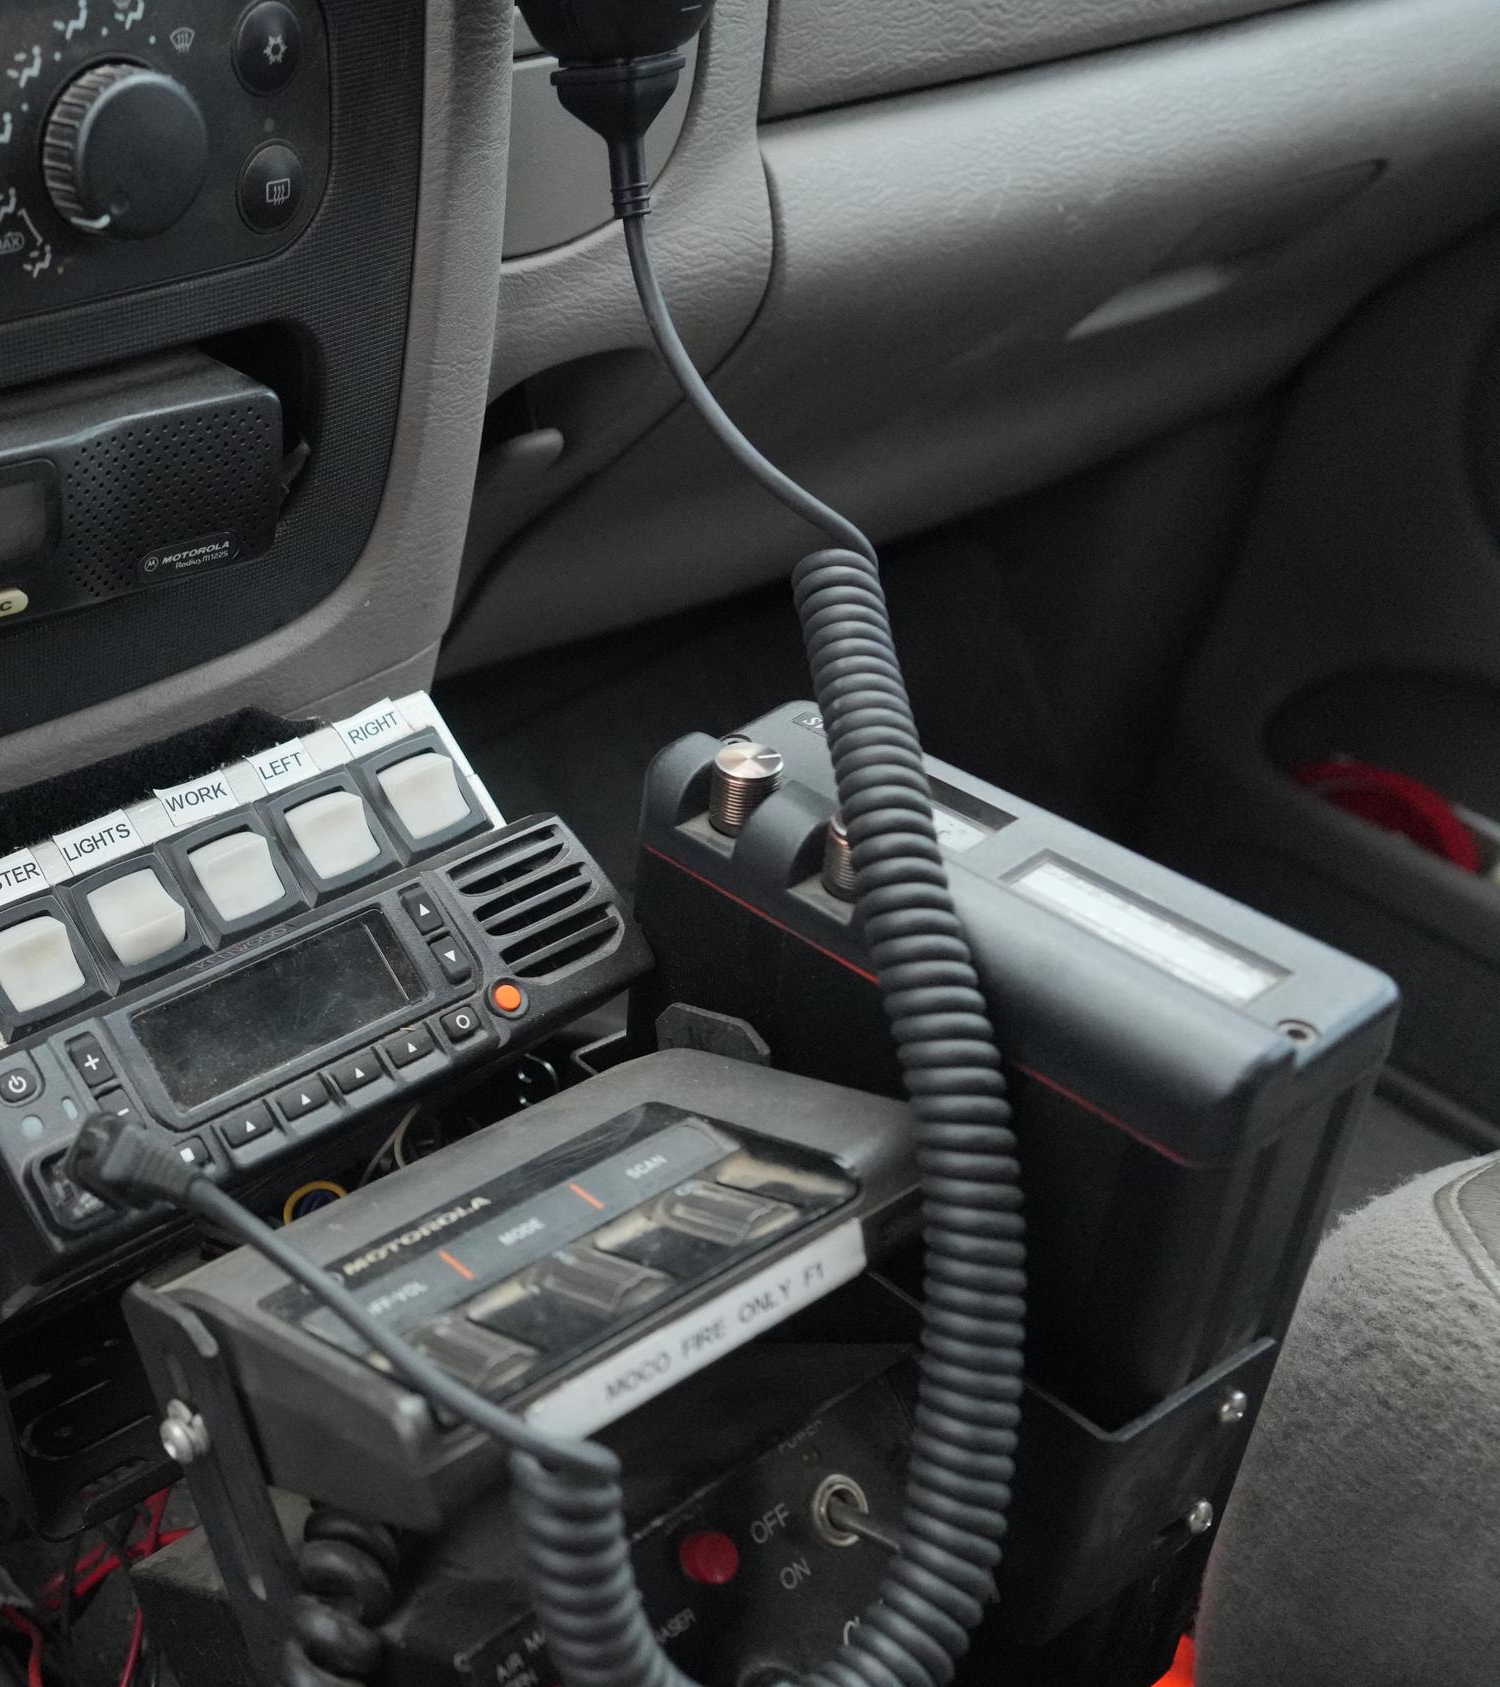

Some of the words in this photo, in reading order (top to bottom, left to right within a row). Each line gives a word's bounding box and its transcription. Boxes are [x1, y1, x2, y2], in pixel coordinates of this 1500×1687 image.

[161, 541, 229, 565] MOTOROLA
[346, 710, 401, 746] RIGHT
[257, 751, 303, 782] LEFT
[164, 782, 228, 814] WORK
[62, 822, 132, 863] LIGHTS
[625, 1154, 668, 1180] SCAN
[342, 1196, 492, 1276] MOTOROLA
[605, 1352, 672, 1400] MOCO
[680, 1316, 726, 1359] FIRE
[737, 1279, 792, 1324] ONLY
[750, 1502, 791, 1544] OFF
[779, 1557, 813, 1591] ON
